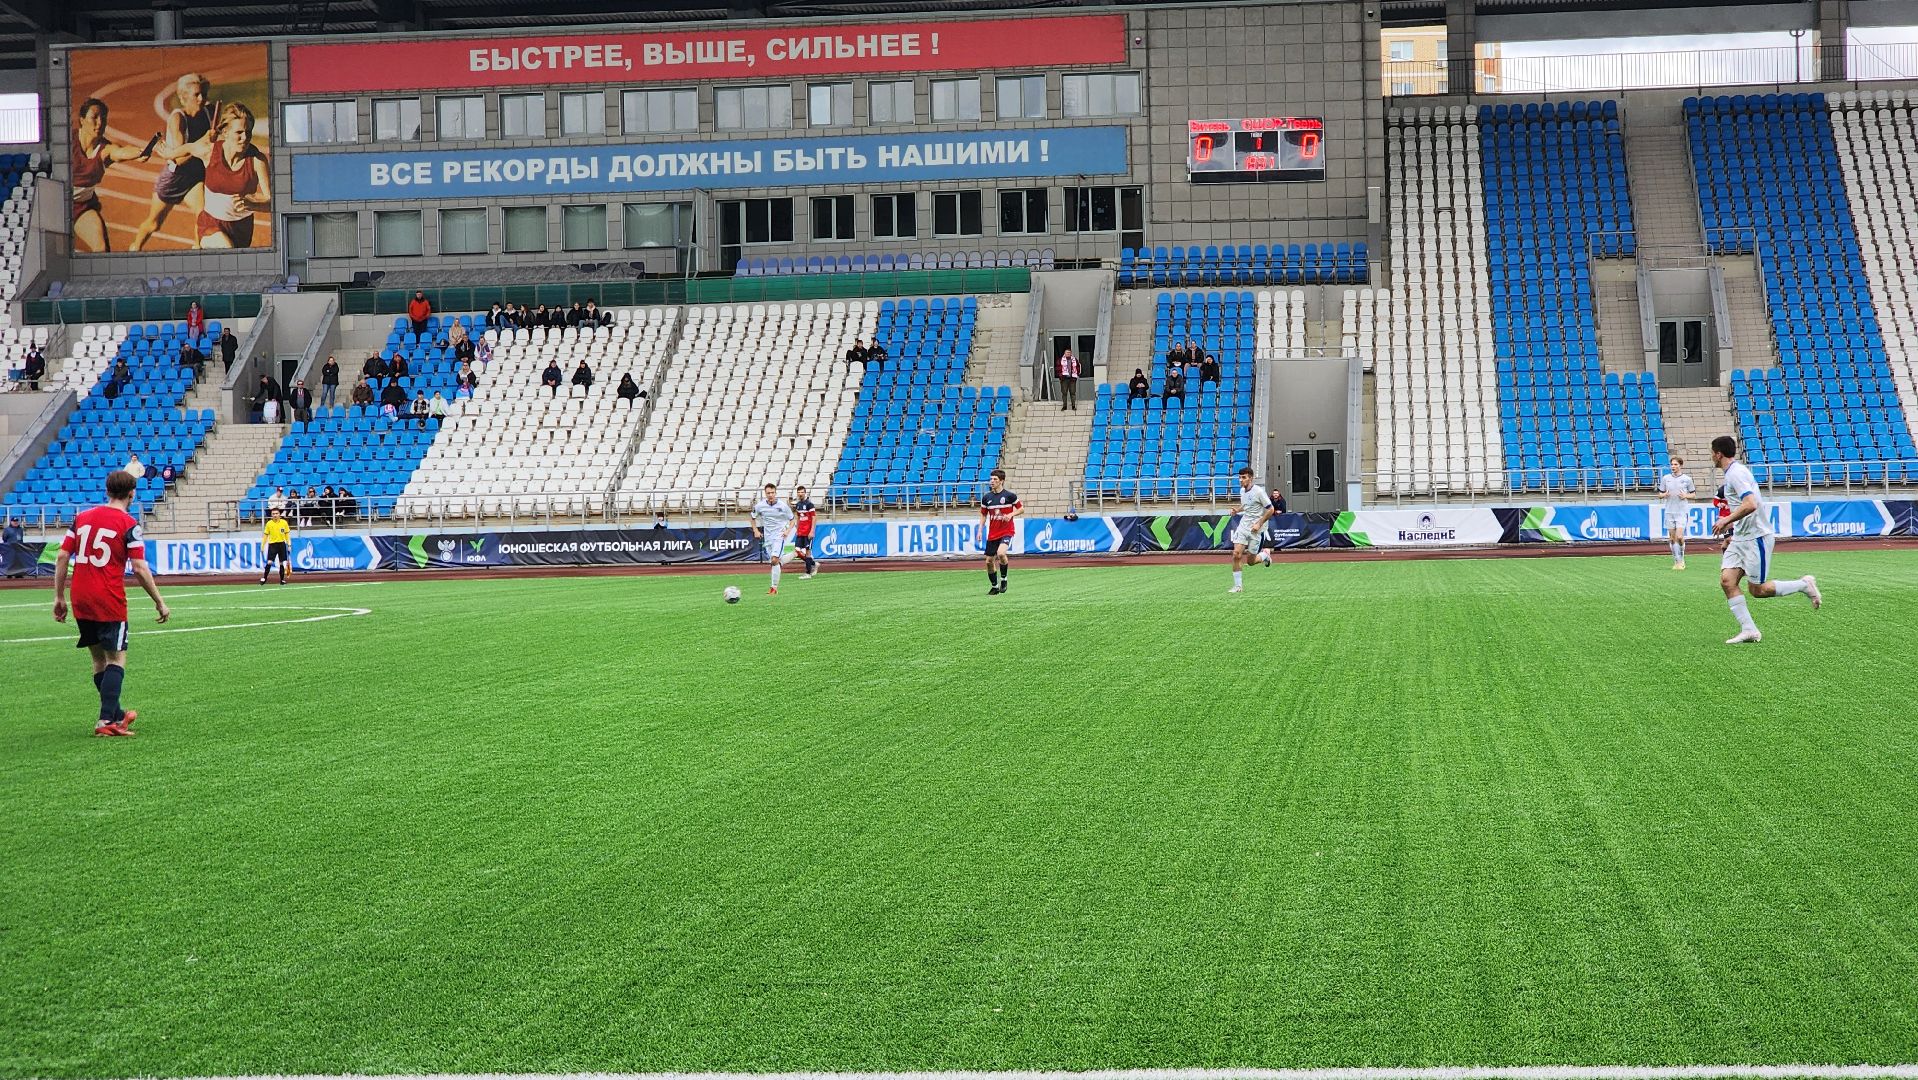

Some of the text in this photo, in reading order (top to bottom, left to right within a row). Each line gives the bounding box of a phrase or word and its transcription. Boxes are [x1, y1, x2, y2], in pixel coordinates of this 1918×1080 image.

[469, 33, 939, 72] БЫСТРЕЕ, ВЫШЕ, СИЛЬНЕЕ !
[1195, 136, 1213, 161] 0
[1302, 133, 1318, 159] 0
[370, 139, 1049, 186] ВСЕ РЕКОРДЫ ДОЛЖНЫ БЫТЬ НАШИМИ !
[898, 523, 1013, 553] ГАЗПРО
[1599, 527, 1641, 539] ГАЗПРОМ
[1822, 522, 1866, 534] ГАЗПРОМ
[75, 524, 118, 568] 15
[498, 539, 750, 554] ЮНОШЕСКАЯ ФУТБОЛЬНАЯ ЛИГА ЦЕНТР
[837, 543, 878, 555] ГАЗПРОМ
[1052, 539, 1096, 551] ГАЗПРОМ
[314, 556, 355, 568] ГАЗПРОМ
